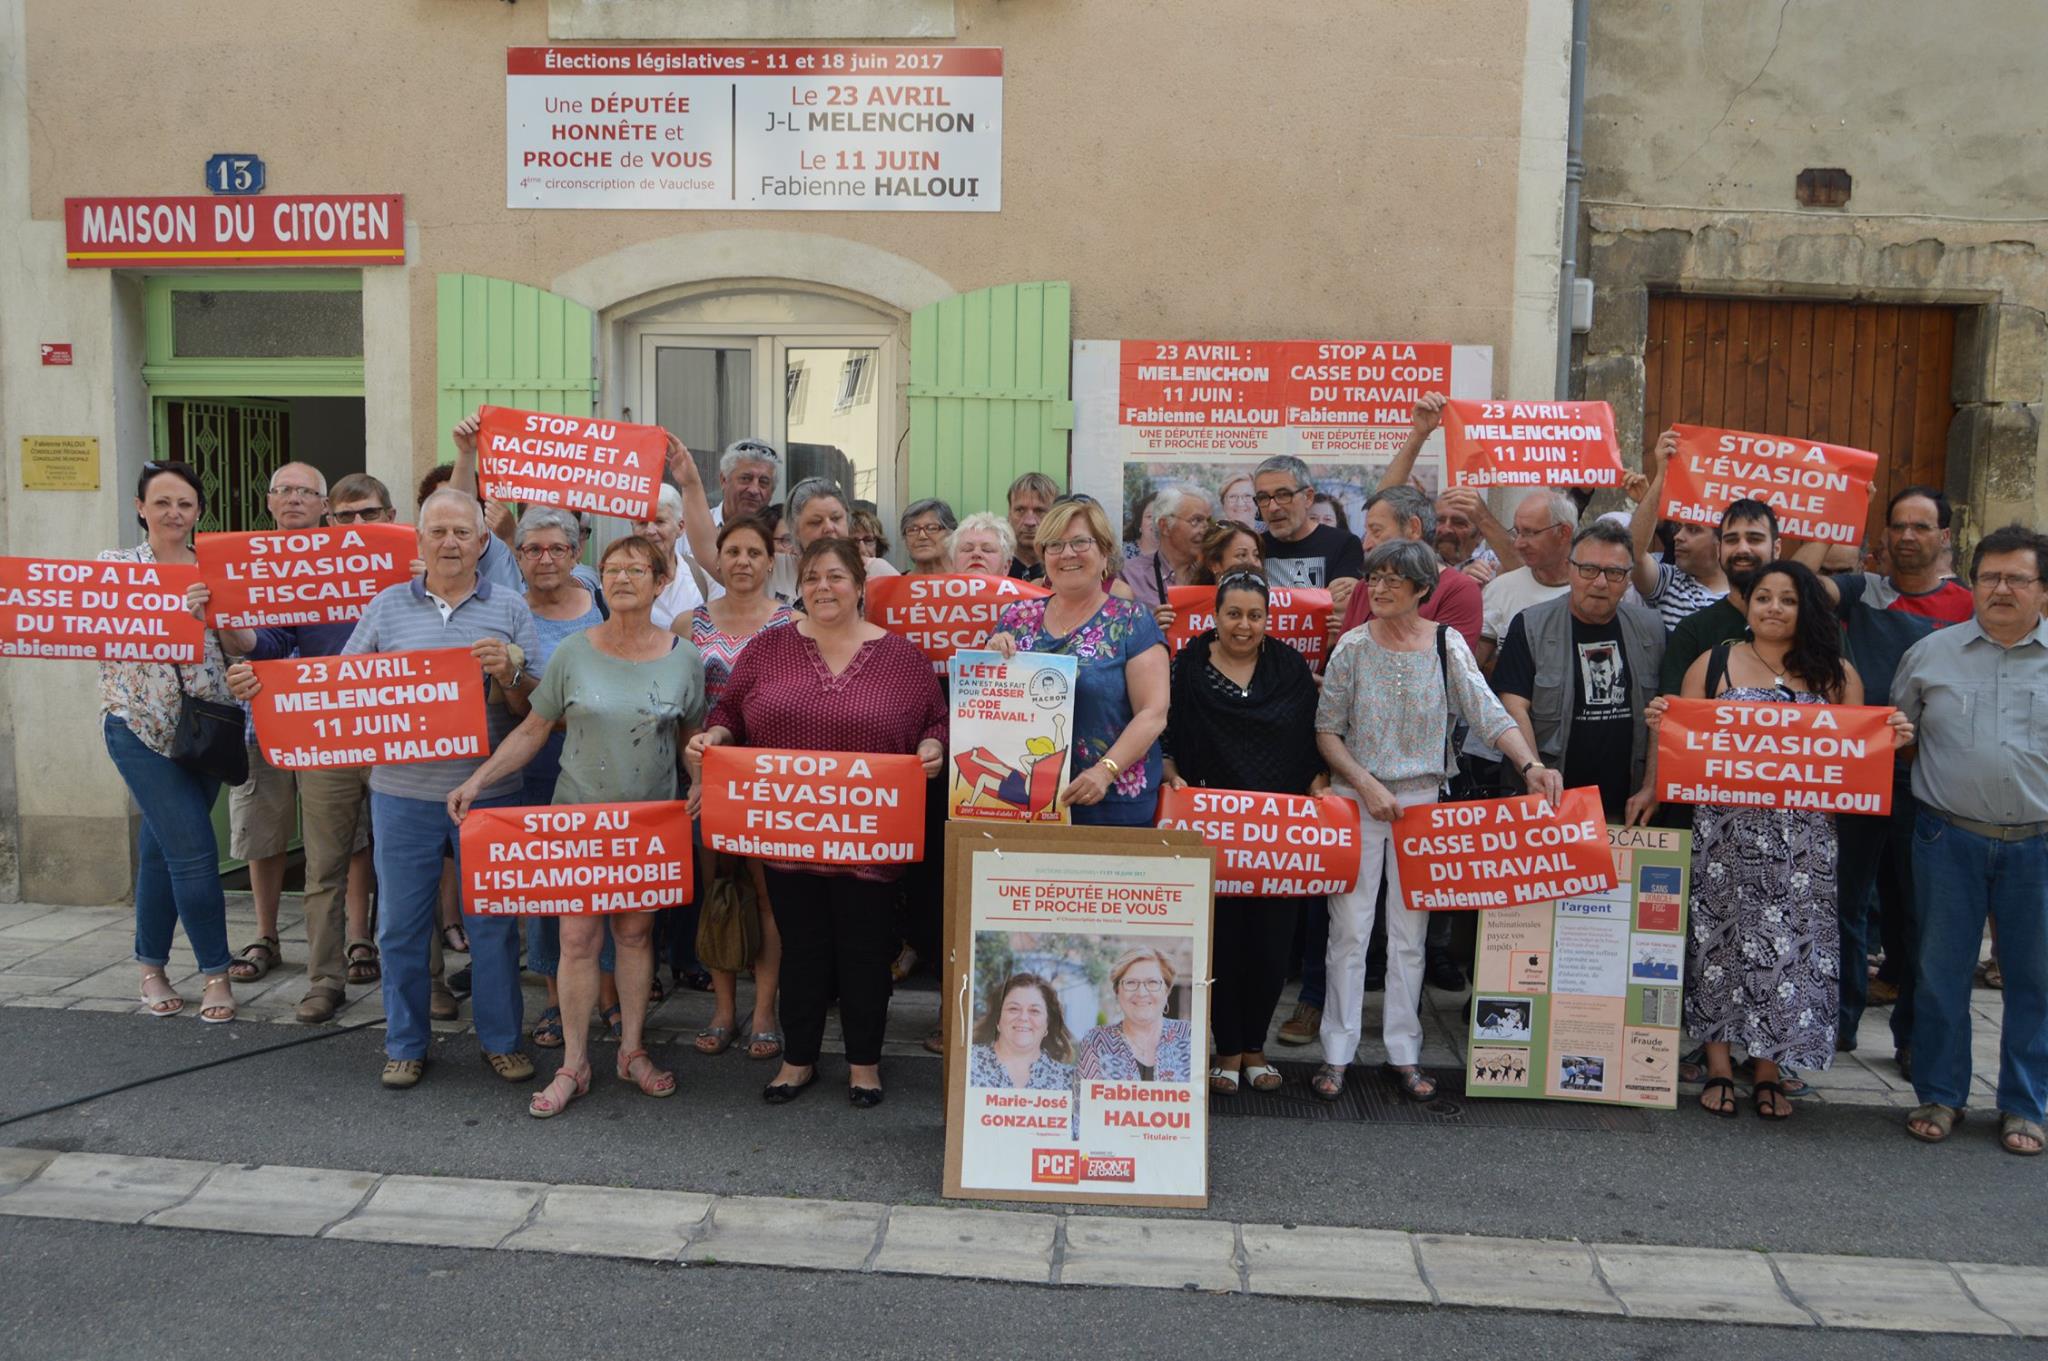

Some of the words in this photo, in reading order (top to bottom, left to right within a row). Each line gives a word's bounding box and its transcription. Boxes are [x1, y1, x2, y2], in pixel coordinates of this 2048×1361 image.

[545, 50, 631, 69] Élections
[637, 52, 745, 72] législatives
[766, 54, 788, 68] 11
[796, 55, 814, 68] et
[821, 54, 844, 68] 18
[850, 53, 888, 72] juin
[895, 54, 943, 69] 2017
[545, 97, 582, 113] Une
[591, 92, 690, 113] DÉPUTÉE
[792, 87, 818, 105] Le
[827, 87, 859, 105] 23
[867, 87, 950, 106] AVRIL
[552, 118, 656, 140] HONNÊTE
[665, 127, 683, 140] et
[765, 112, 800, 133] J-L
[809, 112, 974, 132] MELENCHON
[523, 152, 612, 168] PROCHE
[621, 152, 643, 168] de
[652, 152, 712, 168] VOUS
[801, 151, 826, 170] Le
[836, 151, 864, 170] 11
[874, 151, 940, 171] JUIN
[216, 160, 253, 190] 13
[545, 178, 636, 193] circonscription
[640, 178, 655, 190] de
[659, 178, 714, 190] Vaucluse
[762, 176, 865, 197] Fabienne
[874, 177, 978, 198] HALOUI
[82, 205, 196, 243] MAISON
[215, 205, 254, 242] DU
[273, 201, 389, 241] CITOYEN
[1156, 345, 1178, 360] 23
[1185, 345, 1240, 361] AVRIL
[1318, 345, 1365, 360] STOP
[1371, 345, 1386, 360] A
[1392, 346, 1416, 361] LA
[1138, 366, 1269, 381] MELENCHON
[1290, 366, 1351, 381] CASSE
[1358, 366, 1384, 381] DU
[1391, 367, 1443, 382] CODE
[1163, 388, 1184, 402] 11
[1190, 388, 1231, 402] JUIN
[1310, 387, 1337, 401] DU
[1344, 387, 1421, 402] TRAVAIL
[1126, 408, 1205, 423] Fabienne
[1211, 409, 1278, 424] HALOUI
[1481, 404, 1505, 419] 23
[1511, 404, 1571, 420] AVRIL
[525, 415, 579, 436] STOP
[583, 423, 616, 441] AU
[1465, 425, 1602, 441] MELENCHON
[492, 435, 588, 461] RACISME
[593, 447, 619, 464] ET
[624, 452, 640, 468] A
[1494, 447, 1515, 462] 11
[1522, 447, 1567, 462] JUIN
[1719, 435, 1794, 459] STOP
[1803, 447, 1826, 465] A
[482, 458, 651, 494] L'ISLAMOPHOBIE
[1456, 470, 1540, 486] Fabienne
[1547, 469, 1616, 486] HALOUI
[1690, 455, 1848, 492] L'ÉVASION
[486, 482, 559, 504] Fabienne
[566, 490, 648, 518] HALOUI
[248, 535, 330, 554] STOP
[340, 530, 366, 548] A
[28, 563, 93, 583] STOP
[101, 567, 120, 585] A
[128, 567, 160, 586] LA
[225, 552, 394, 580] L'ÉVASION
[81, 591, 119, 609] DU
[248, 579, 378, 605] FISCALE
[16, 614, 54, 633] DU
[62, 615, 170, 636] TRAVAIL
[215, 607, 321, 629] Fabienne
[105, 642, 195, 661] HALOUI
[297, 663, 329, 682] 23
[337, 659, 415, 681] AVRIL
[960, 662, 1007, 679] L'ÉTÉ
[275, 681, 459, 712] MELENCHON
[969, 699, 1001, 709] CODE
[982, 688, 1024, 698] CASSER
[313, 718, 342, 738] 11
[351, 714, 412, 736] JUIN
[958, 709, 975, 718] DU
[978, 711, 1028, 721] TRAVAIL
[1715, 706, 1800, 728] STOP
[1812, 710, 1838, 730] A
[270, 742, 377, 767] Fabienne
[383, 736, 479, 760] HALOUI
[1686, 728, 1866, 758] L'ÉVASION
[755, 754, 838, 776] STOP
[847, 759, 872, 779] A
[1705, 759, 1844, 784] FISCALE
[728, 779, 898, 807] L'ÉVASION
[1667, 783, 1776, 806] Fabienne
[1784, 790, 1881, 812] HALOUI
[1193, 793, 1254, 814] STOP
[1261, 797, 1280, 816] A
[1287, 798, 1318, 819] LA
[1432, 806, 1486, 828] STOP
[1496, 805, 1513, 823] A
[1521, 800, 1555, 821] LA
[524, 813, 587, 834] STOP
[593, 810, 630, 830] AU
[746, 810, 877, 834] FISCALE
[1243, 822, 1279, 844] DU
[1286, 825, 1352, 847] CODE
[1403, 833, 1474, 856] CASSE
[1481, 830, 1518, 853] DU
[1525, 821, 1597, 848] CODE
[489, 839, 603, 862] RACISME
[611, 837, 641, 857] ET
[647, 836, 666, 854] A
[711, 834, 814, 859] Fabienne
[823, 840, 914, 860] HALOUI
[1224, 850, 1326, 872] TRAVAIL
[1430, 862, 1461, 882] DU
[1468, 852, 1576, 880] TRAVAIL
[474, 862, 681, 891] L'ISLAMOPHOBIE
[1262, 878, 1347, 895] HALOUI
[473, 897, 584, 914] Fabienne
[591, 888, 683, 911] HALOUI
[999, 885, 1031, 898] UNE
[1036, 884, 1103, 899] DÉPUTÉE
[1108, 887, 1182, 902] HONNÊTE
[1411, 889, 1507, 910] Fabienne
[1515, 873, 1607, 902] HALOUI
[1013, 900, 1030, 911] ET
[1035, 901, 1097, 913] PROCHE
[1102, 902, 1121, 914] DE
[1125, 903, 1167, 915] VOUS
[1562, 902, 1612, 914] l'argent
[1487, 921, 1541, 929] Multinationales
[1487, 932, 1510, 942] payez
[986, 1094, 1068, 1109] Marie-José
[1091, 1084, 1190, 1102] Fabienne
[980, 1114, 1067, 1129] GONZALEZ
[1104, 1110, 1190, 1129] HALOUI
[1142, 1133, 1177, 1141] Titulaire
[1038, 1154, 1074, 1175] PCF
[1088, 1160, 1130, 1171] FRONT
